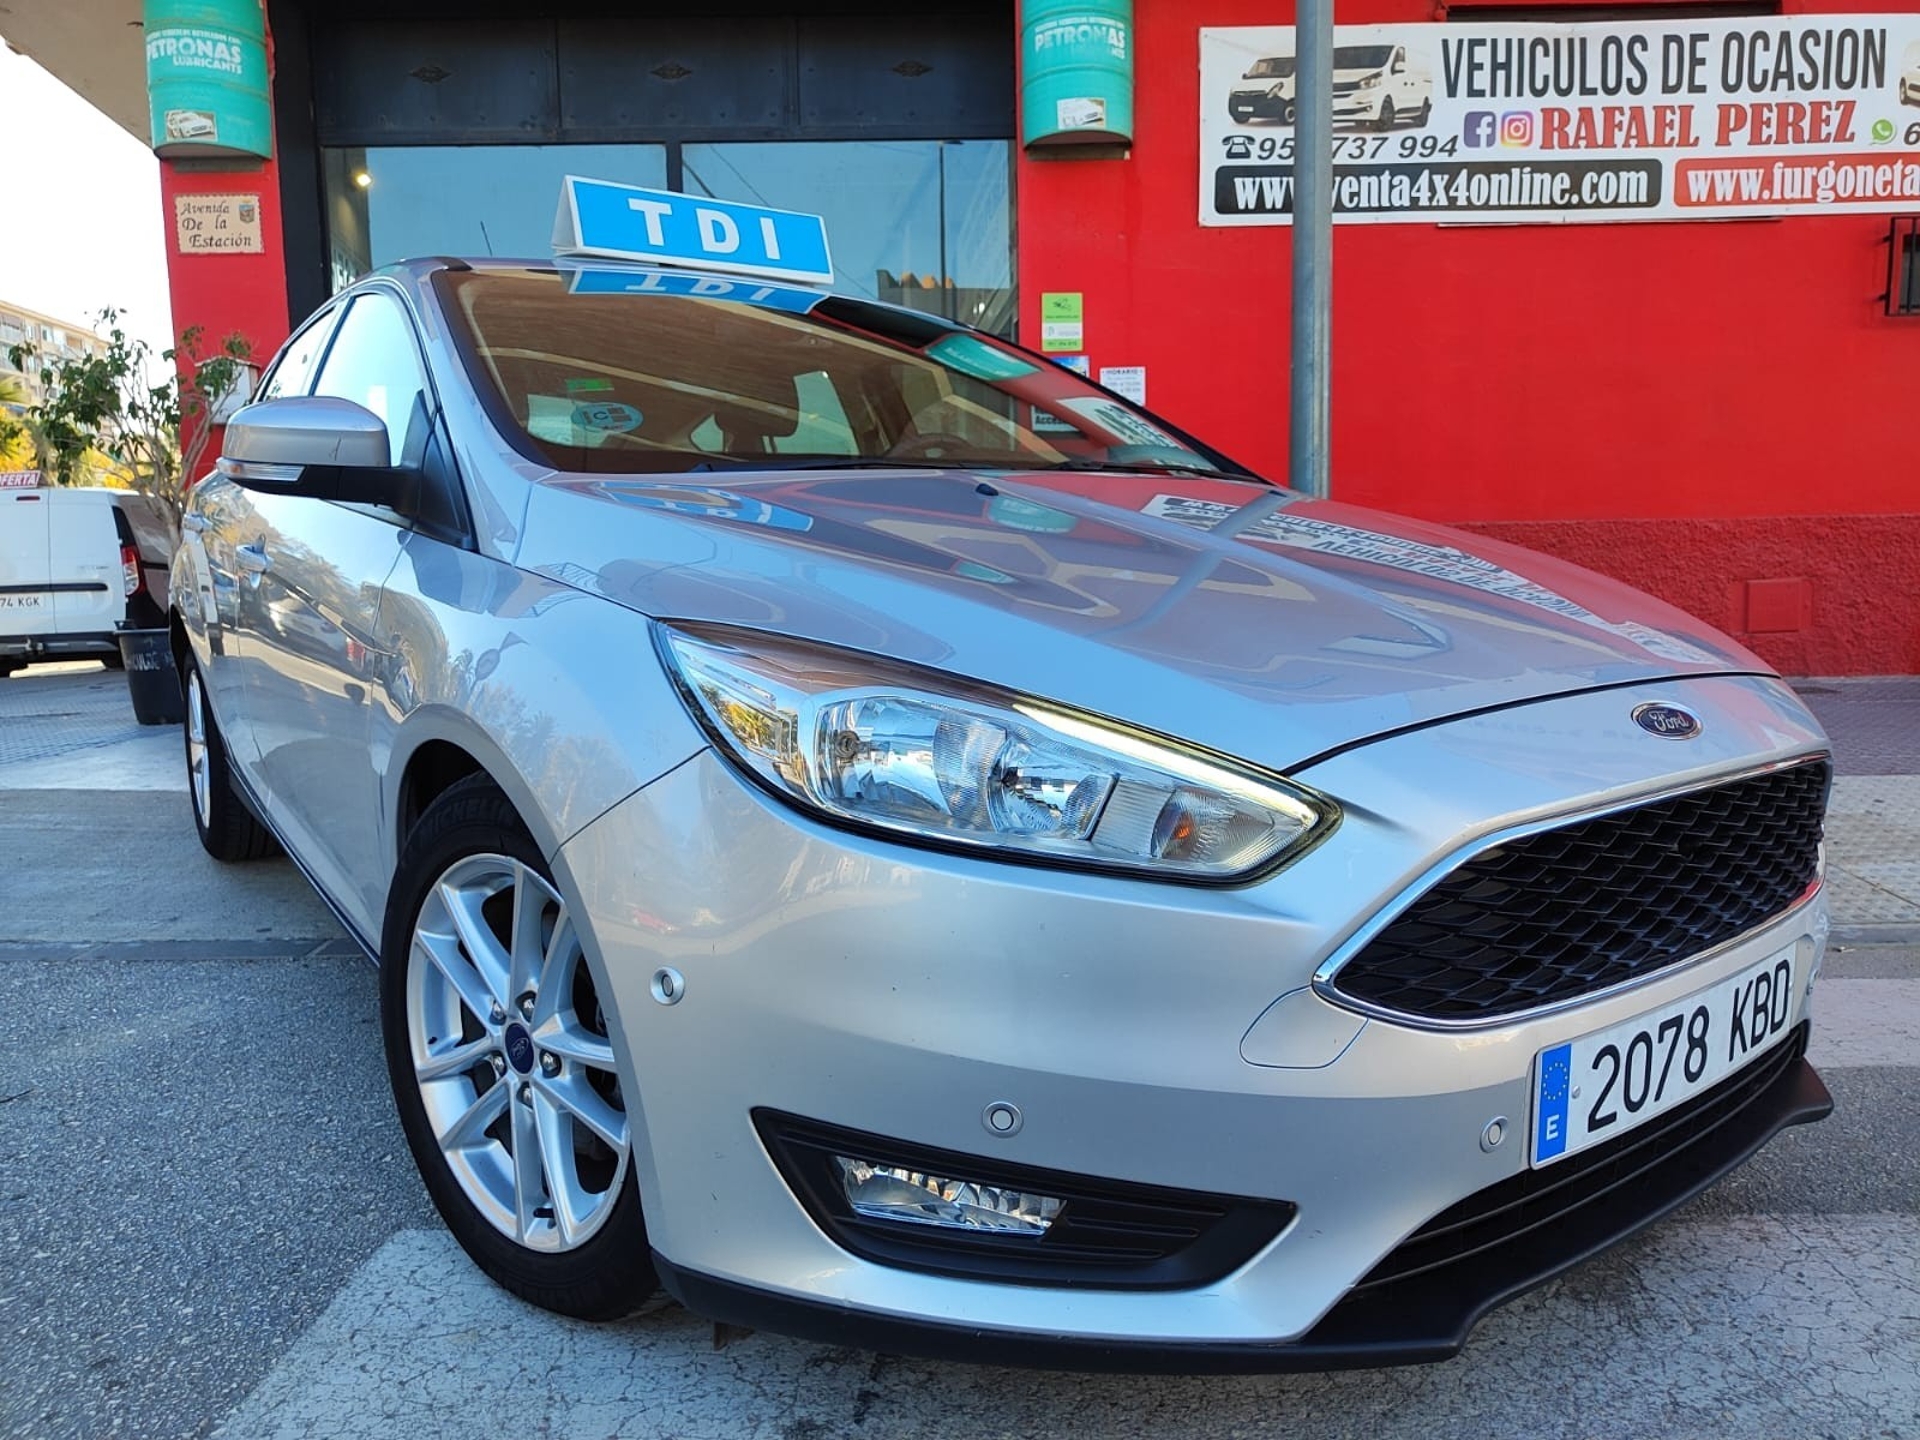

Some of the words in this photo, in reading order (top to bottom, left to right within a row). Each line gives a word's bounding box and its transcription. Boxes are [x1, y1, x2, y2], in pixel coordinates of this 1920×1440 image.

[172, 54, 243, 74] LUBRICANTS
[1442, 34, 1648, 98] VEHICULOS
[1661, 33, 1709, 95] DE
[1721, 28, 1886, 94] OCASION
[1540, 104, 1700, 150] RAFAEL
[1715, 100, 1857, 147] PEREZ
[1257, 136, 1297, 160] 95
[1331, 136, 1389, 160] 737
[1398, 134, 1460, 158] 994
[1234, 166, 1649, 210] wwventa4x4online.com
[180, 200, 230, 216] Avenida
[182, 217, 203, 231] De
[214, 213, 227, 230] la
[188, 232, 252, 248] Estación
[0, 473, 38, 487] FERTA
[18, 596, 39, 607] KGK
[1648, 709, 1690, 732] Ford
[1587, 1004, 1711, 1134] 2078
[1728, 958, 1790, 1063] KBD
[1545, 1114, 1559, 1142] E
